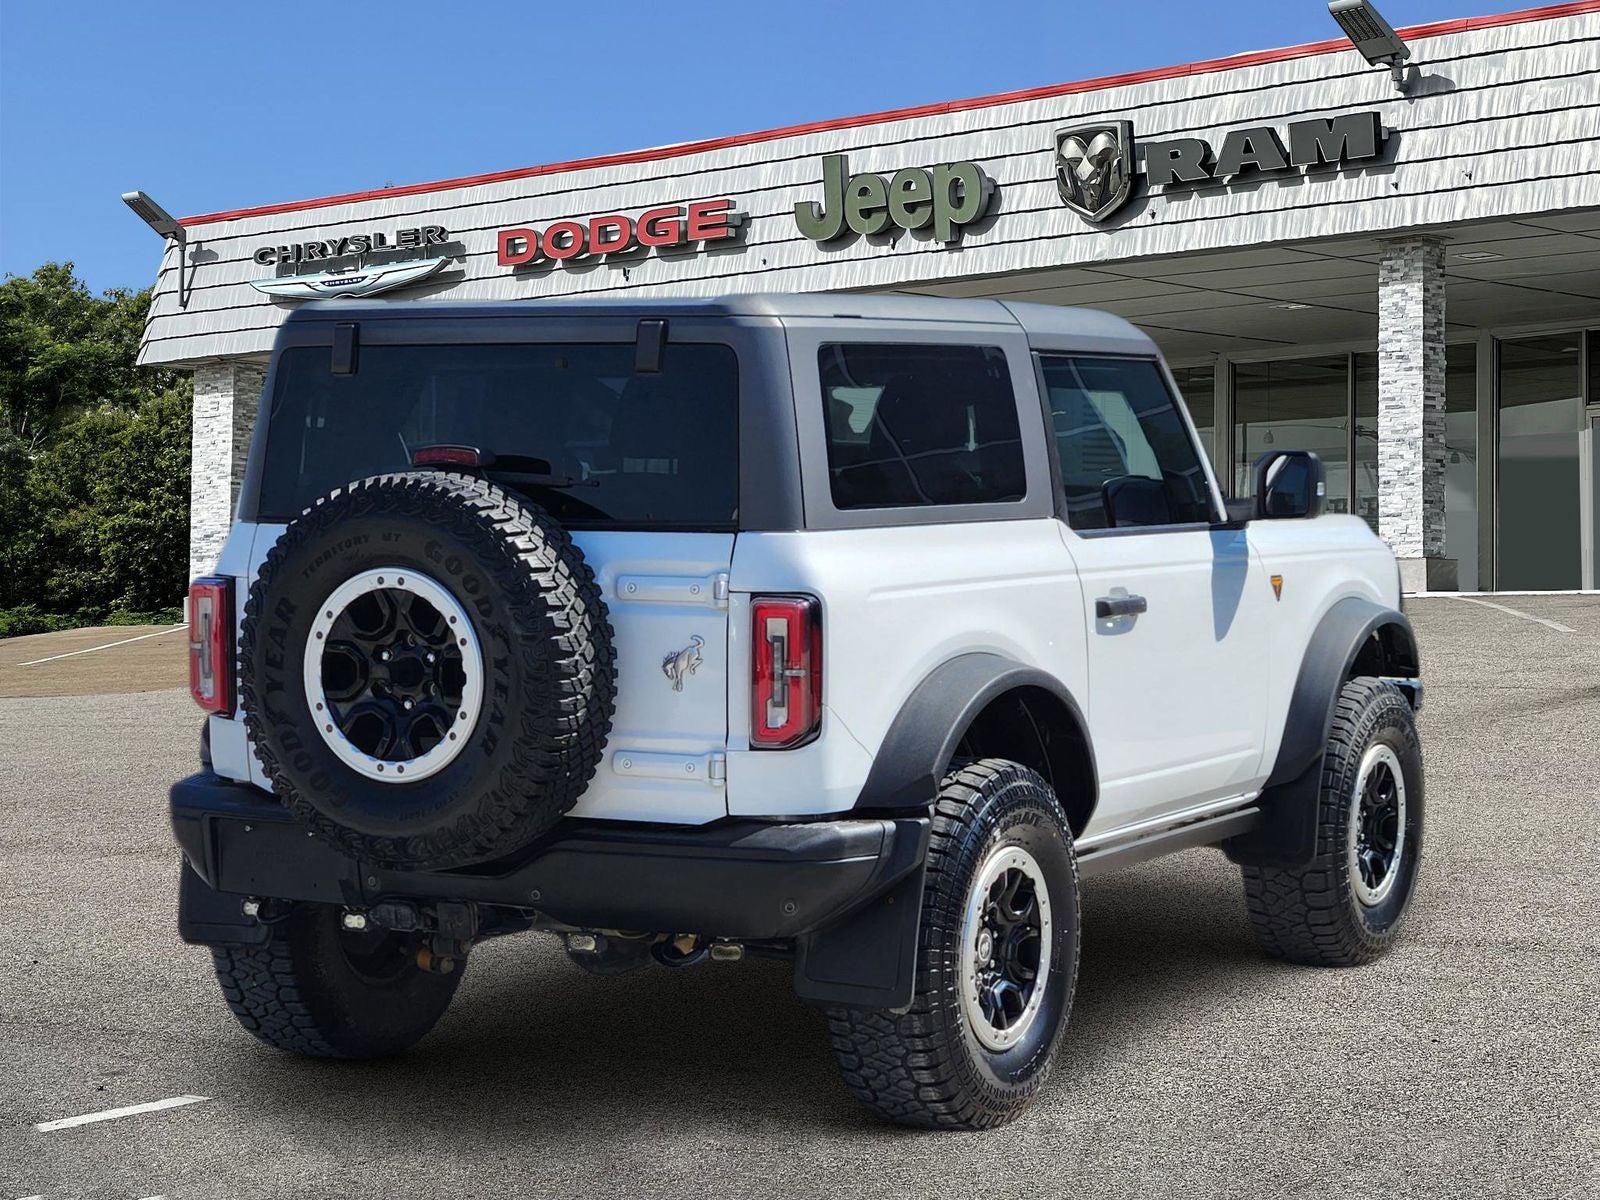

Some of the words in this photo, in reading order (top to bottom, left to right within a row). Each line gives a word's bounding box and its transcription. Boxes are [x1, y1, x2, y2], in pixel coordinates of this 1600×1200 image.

[1145, 111, 1381, 187] RAM
[794, 154, 988, 242] Jeep
[253, 225, 448, 267] CHRYSLER
[497, 199, 735, 267] DODGE
[324, 277, 363, 286] CHRYSLER
[302, 534, 370, 579] TERRITORY
